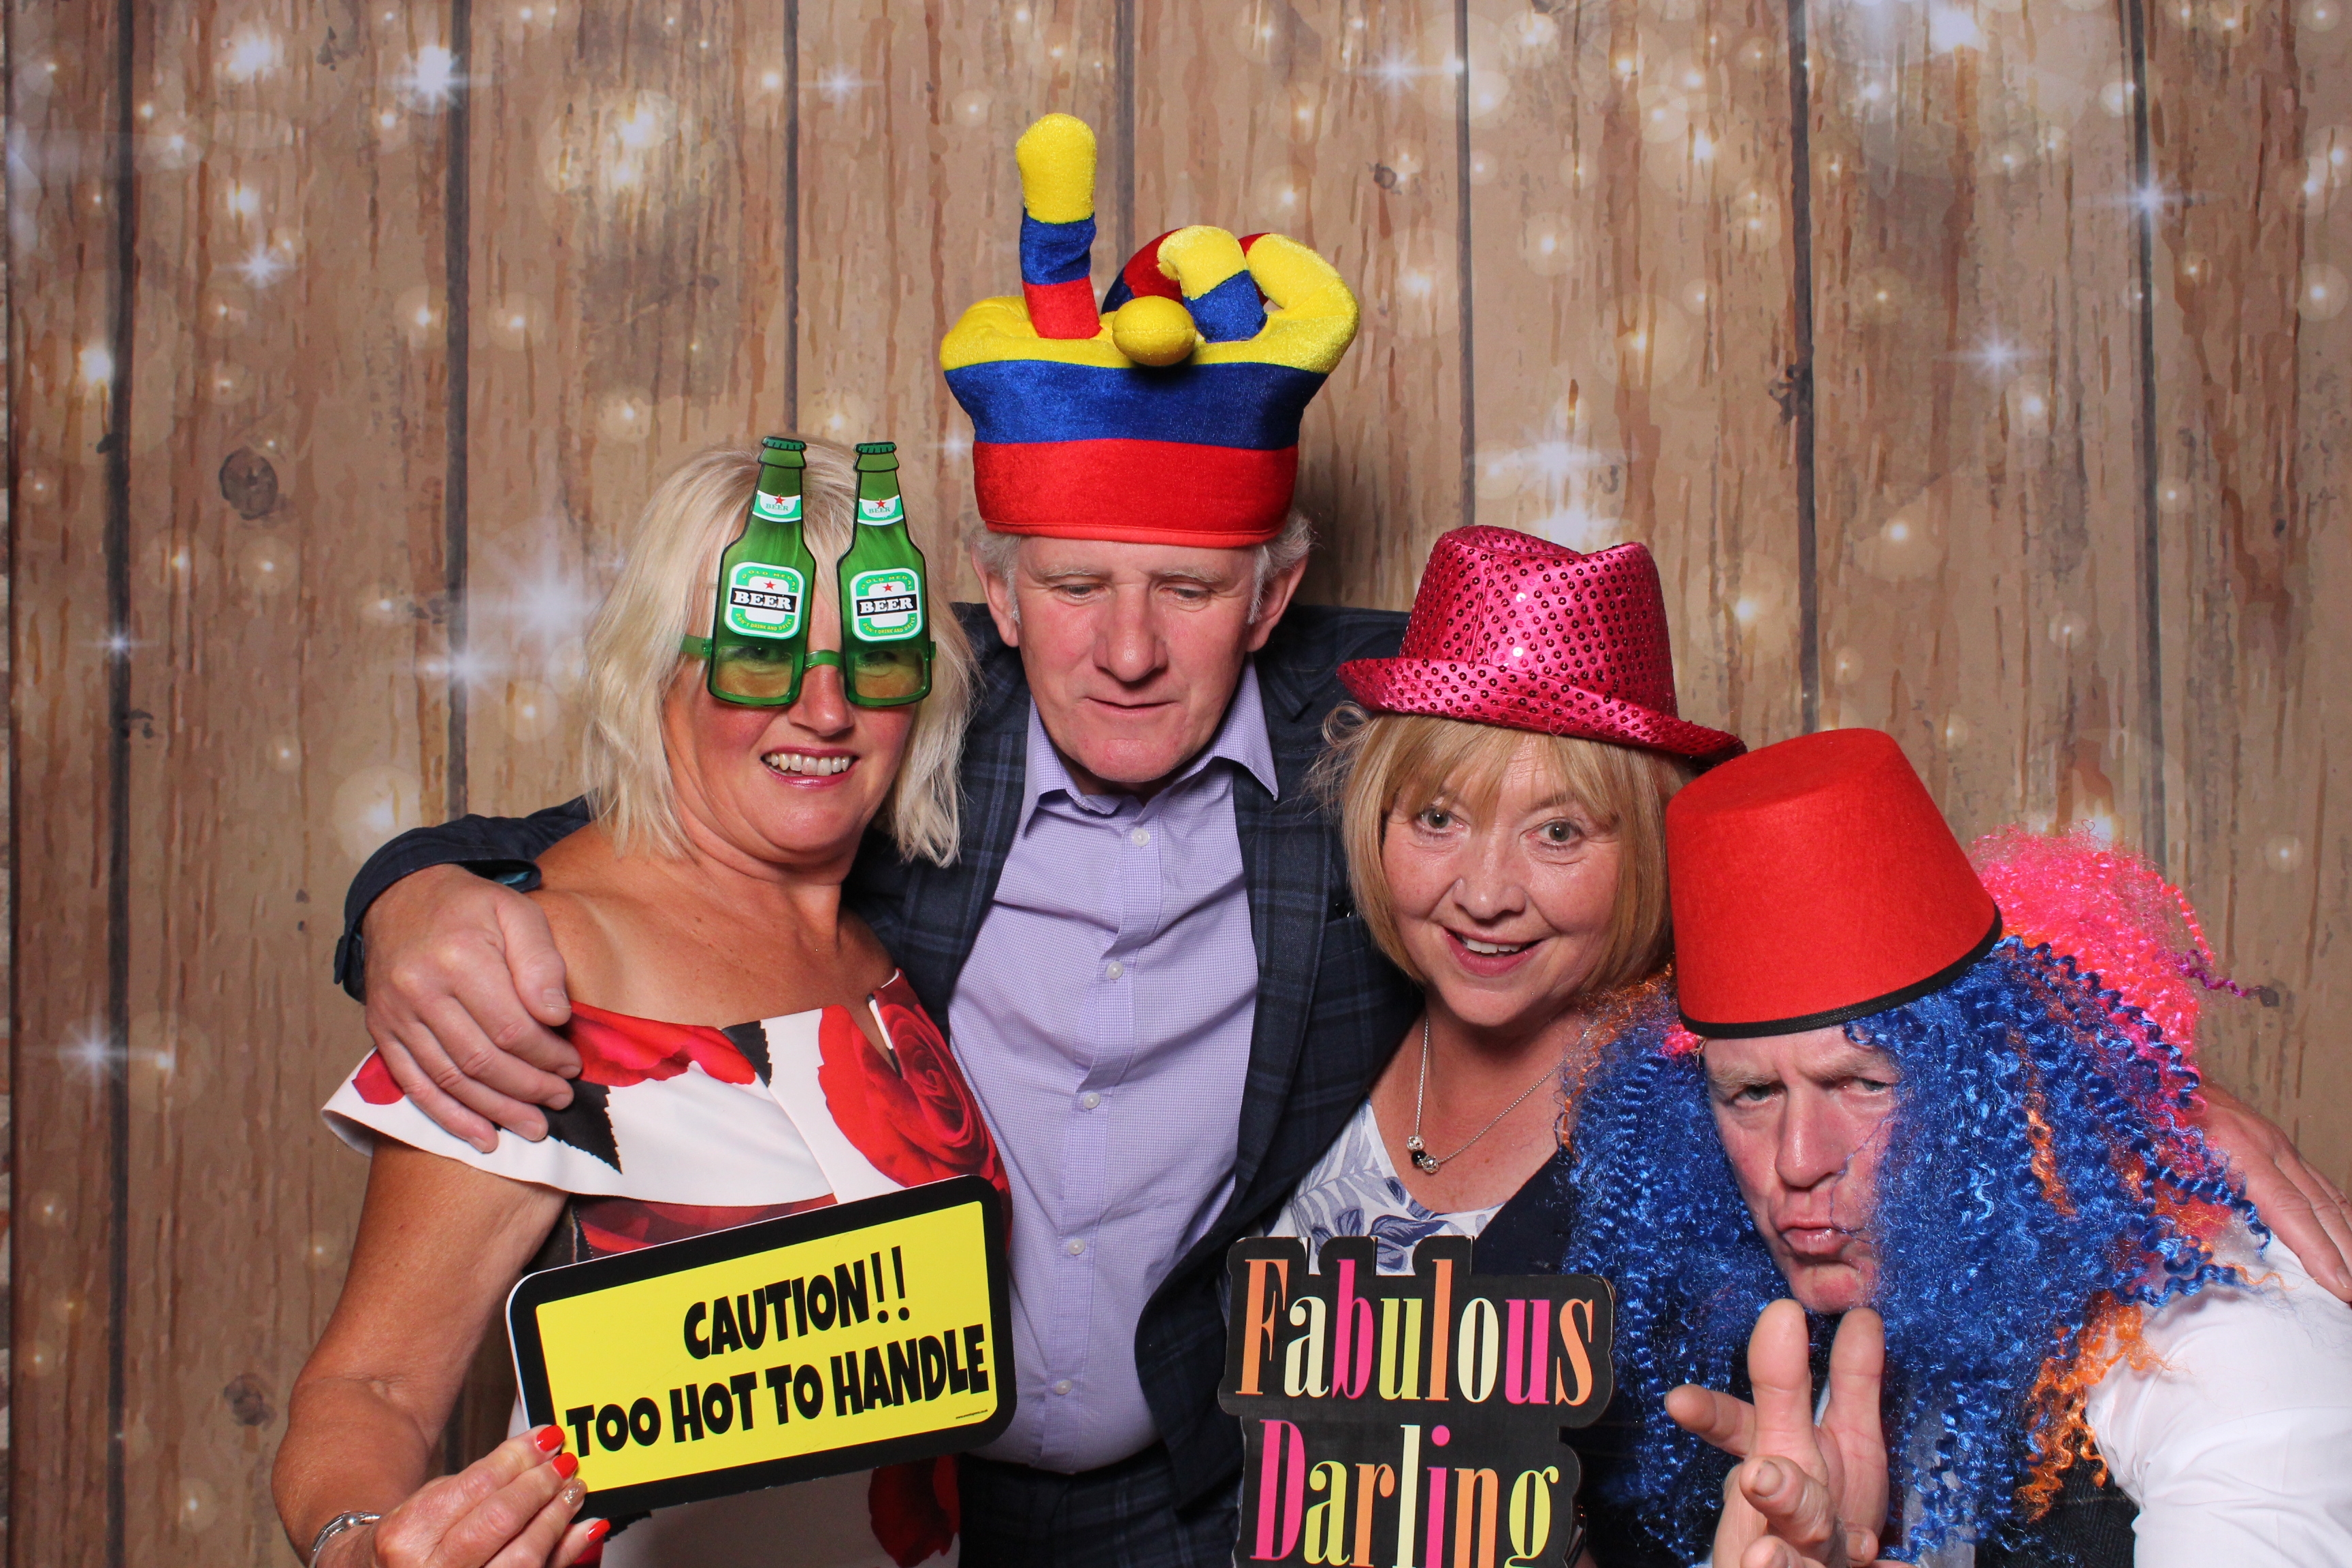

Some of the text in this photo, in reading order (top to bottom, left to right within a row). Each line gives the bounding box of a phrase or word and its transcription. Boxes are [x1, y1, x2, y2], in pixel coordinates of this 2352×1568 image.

[766, 503, 789, 511] BEER
[742, 570, 768, 579] GOLD
[861, 575, 912, 590] GOLD MEDAL
[734, 591, 791, 610] BEER
[860, 597, 913, 614] BEER
[779, 618, 792, 631] DRIVE
[904, 617, 915, 631] DRIVE
[683, 1245, 911, 1359] CAUTION!!
[1235, 1258, 1593, 1406] Fabulous
[566, 1324, 990, 1458] TOO HOT TO HANDLE
[1250, 1419, 1559, 1568] Darling
